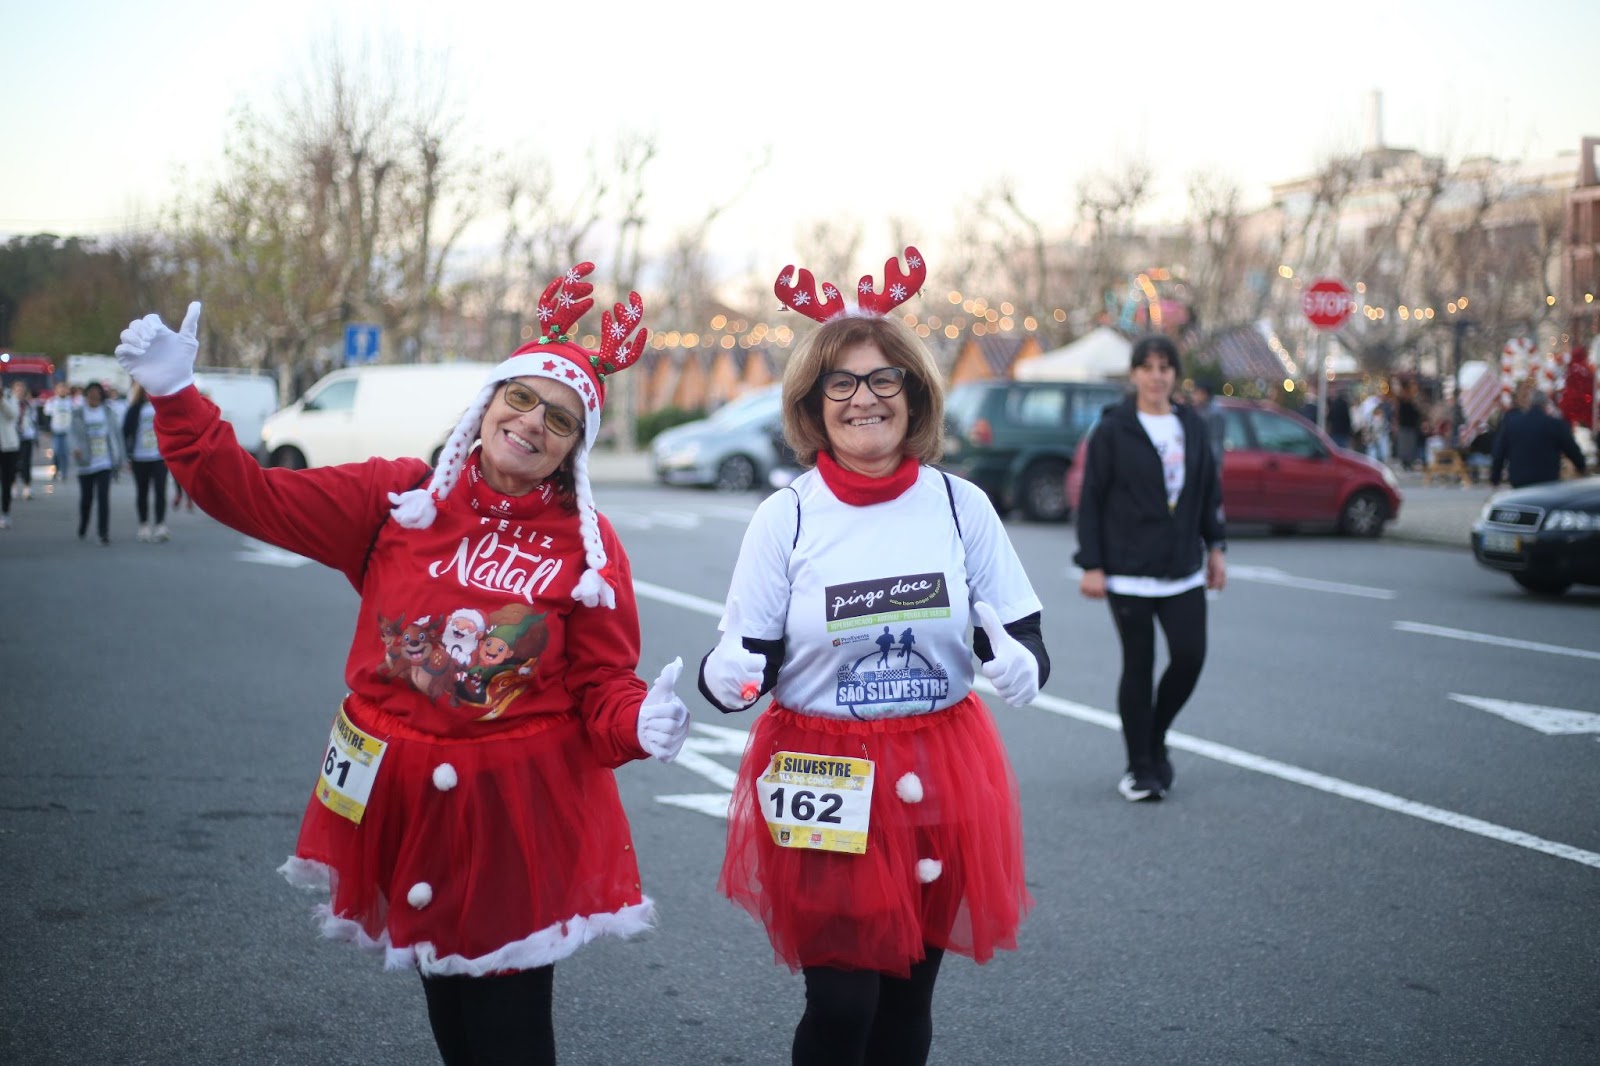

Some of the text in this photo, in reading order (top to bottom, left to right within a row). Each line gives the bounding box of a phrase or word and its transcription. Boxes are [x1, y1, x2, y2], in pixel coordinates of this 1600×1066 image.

[1301, 290, 1352, 316] STOP
[428, 532, 563, 604] Natal
[831, 578, 933, 618] pingo doce
[838, 678, 949, 703] SÃO SILVESTRE
[324, 739, 351, 789] 61
[784, 757, 852, 777] SILVESTRE
[770, 787, 844, 824] 162
